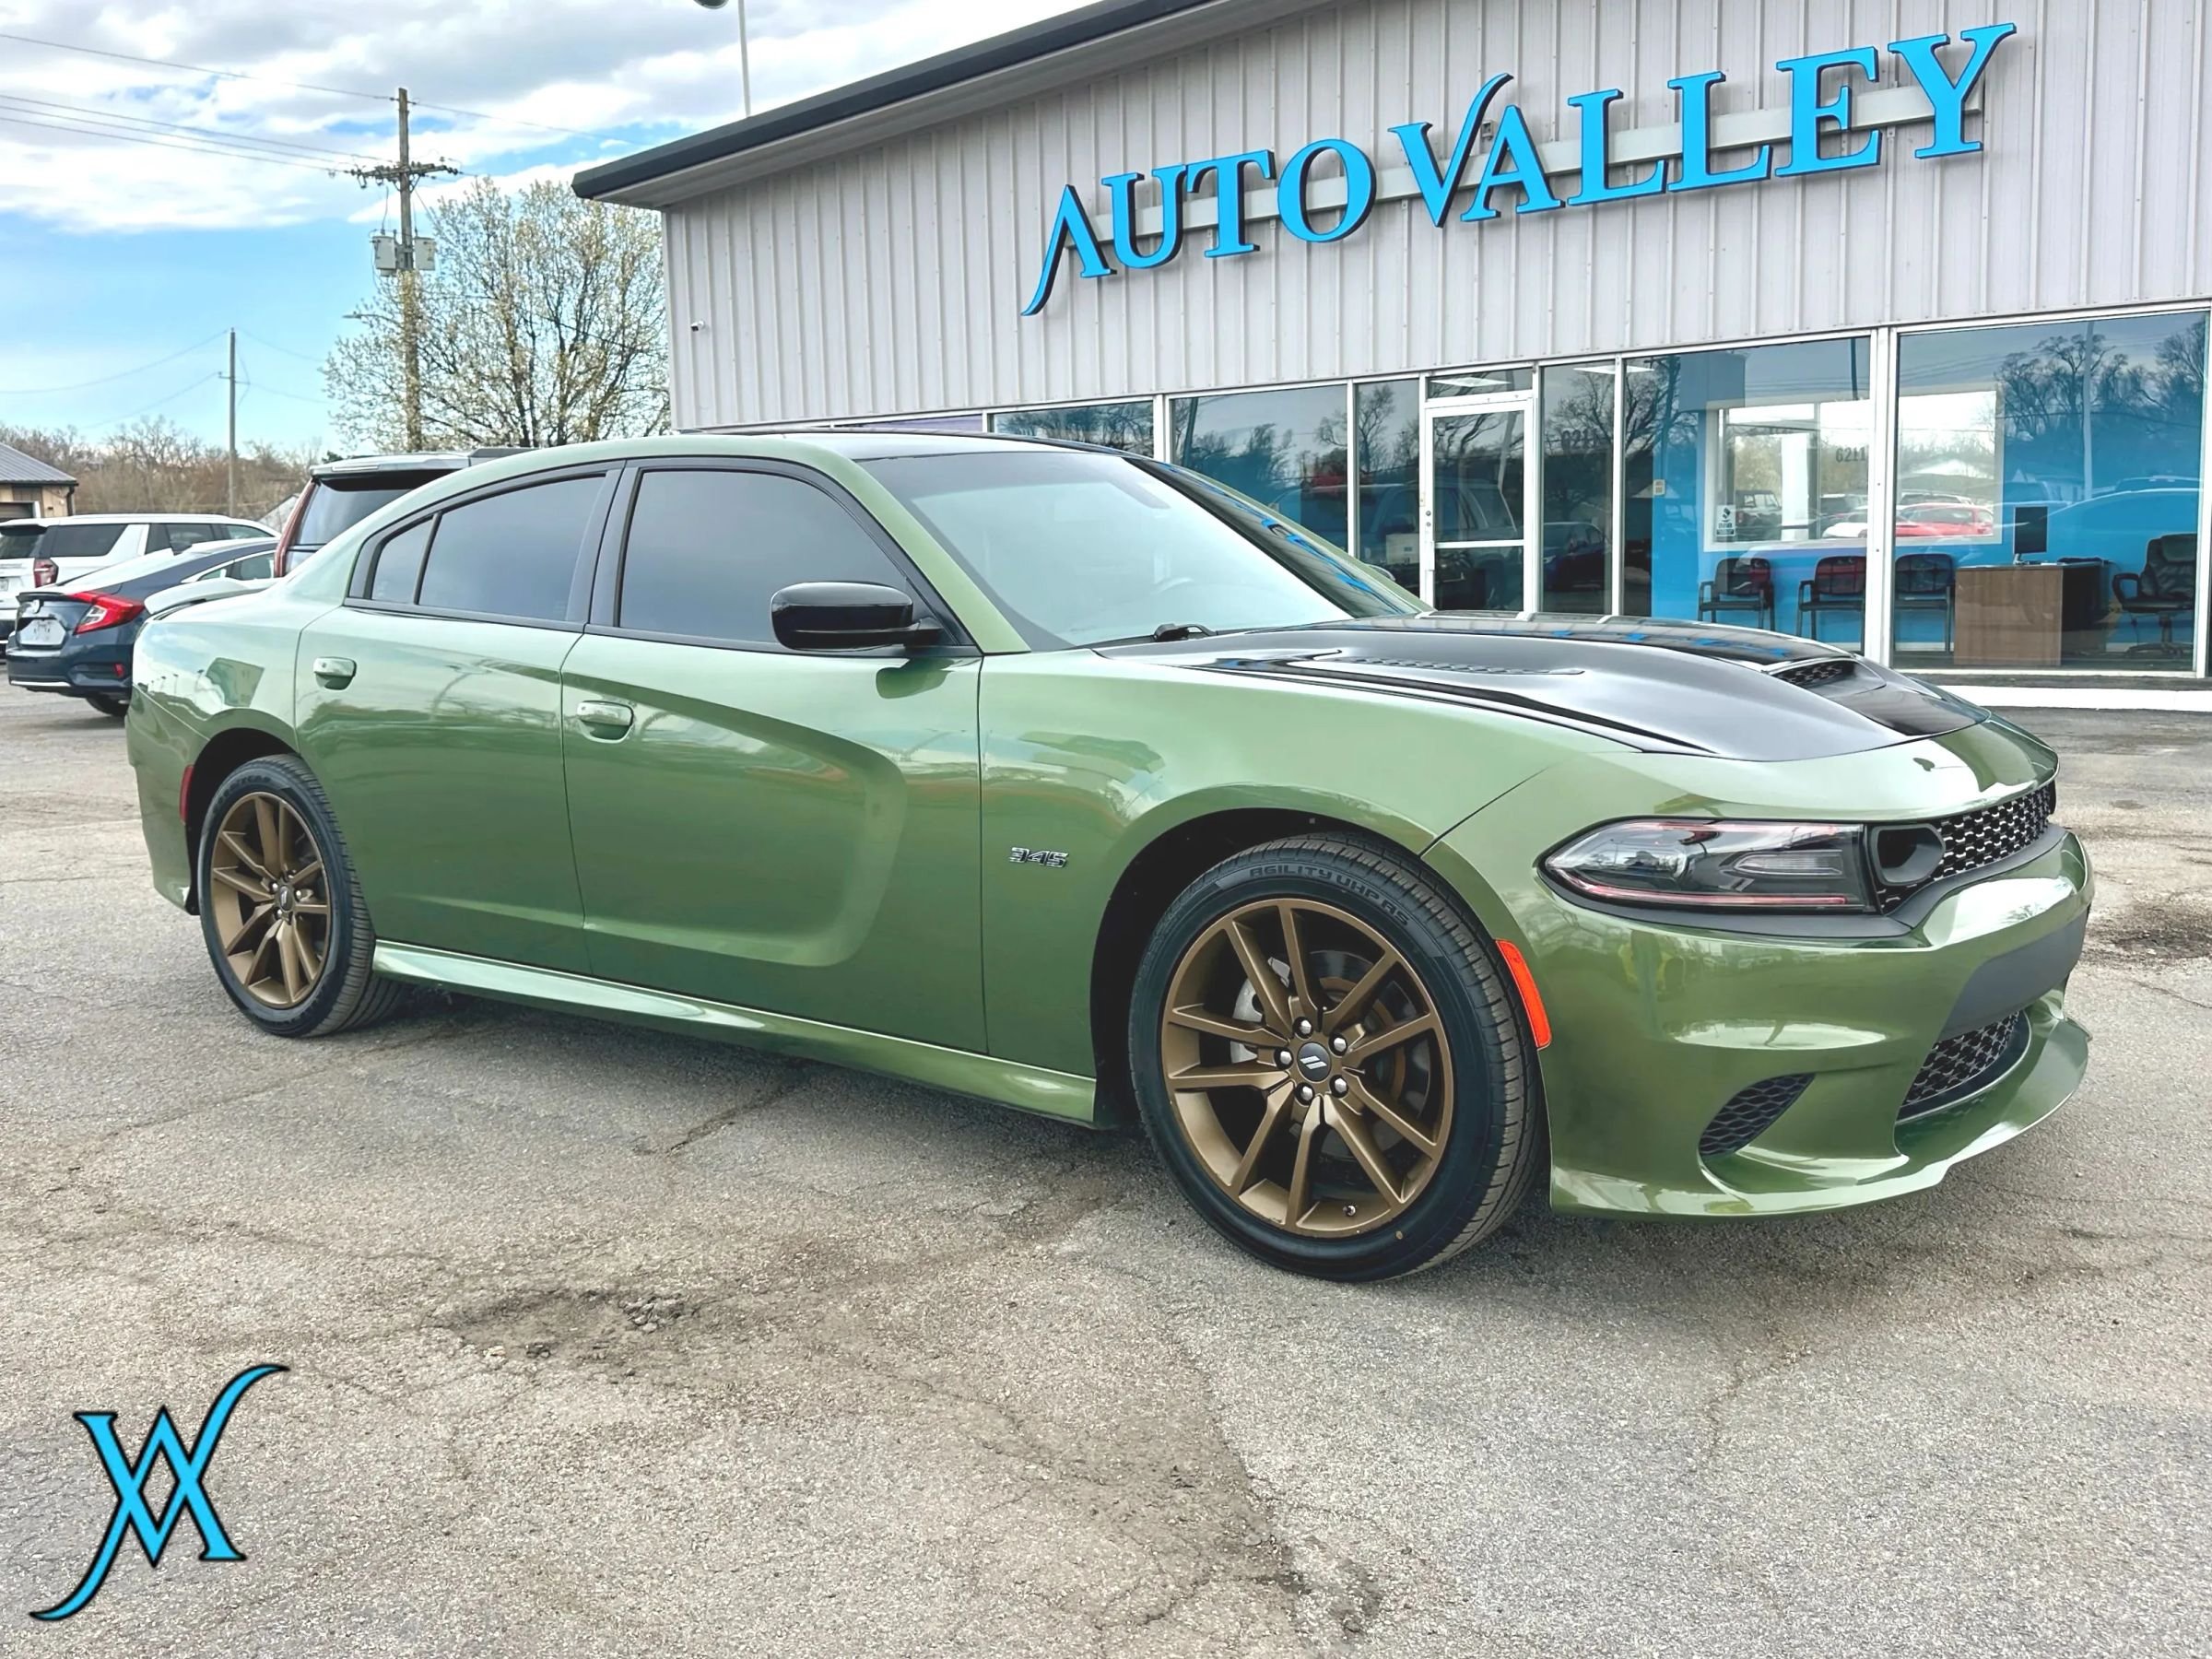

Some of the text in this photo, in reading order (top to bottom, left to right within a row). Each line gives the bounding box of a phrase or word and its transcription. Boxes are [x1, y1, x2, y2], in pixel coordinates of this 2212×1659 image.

[1020, 23, 2018, 316] AUTO VALLEY
[1835, 446, 1866, 463] 6211
[1009, 847, 1069, 867] 345
[1250, 865, 1333, 882] AGILITY
[1336, 876, 1380, 900] UHP
